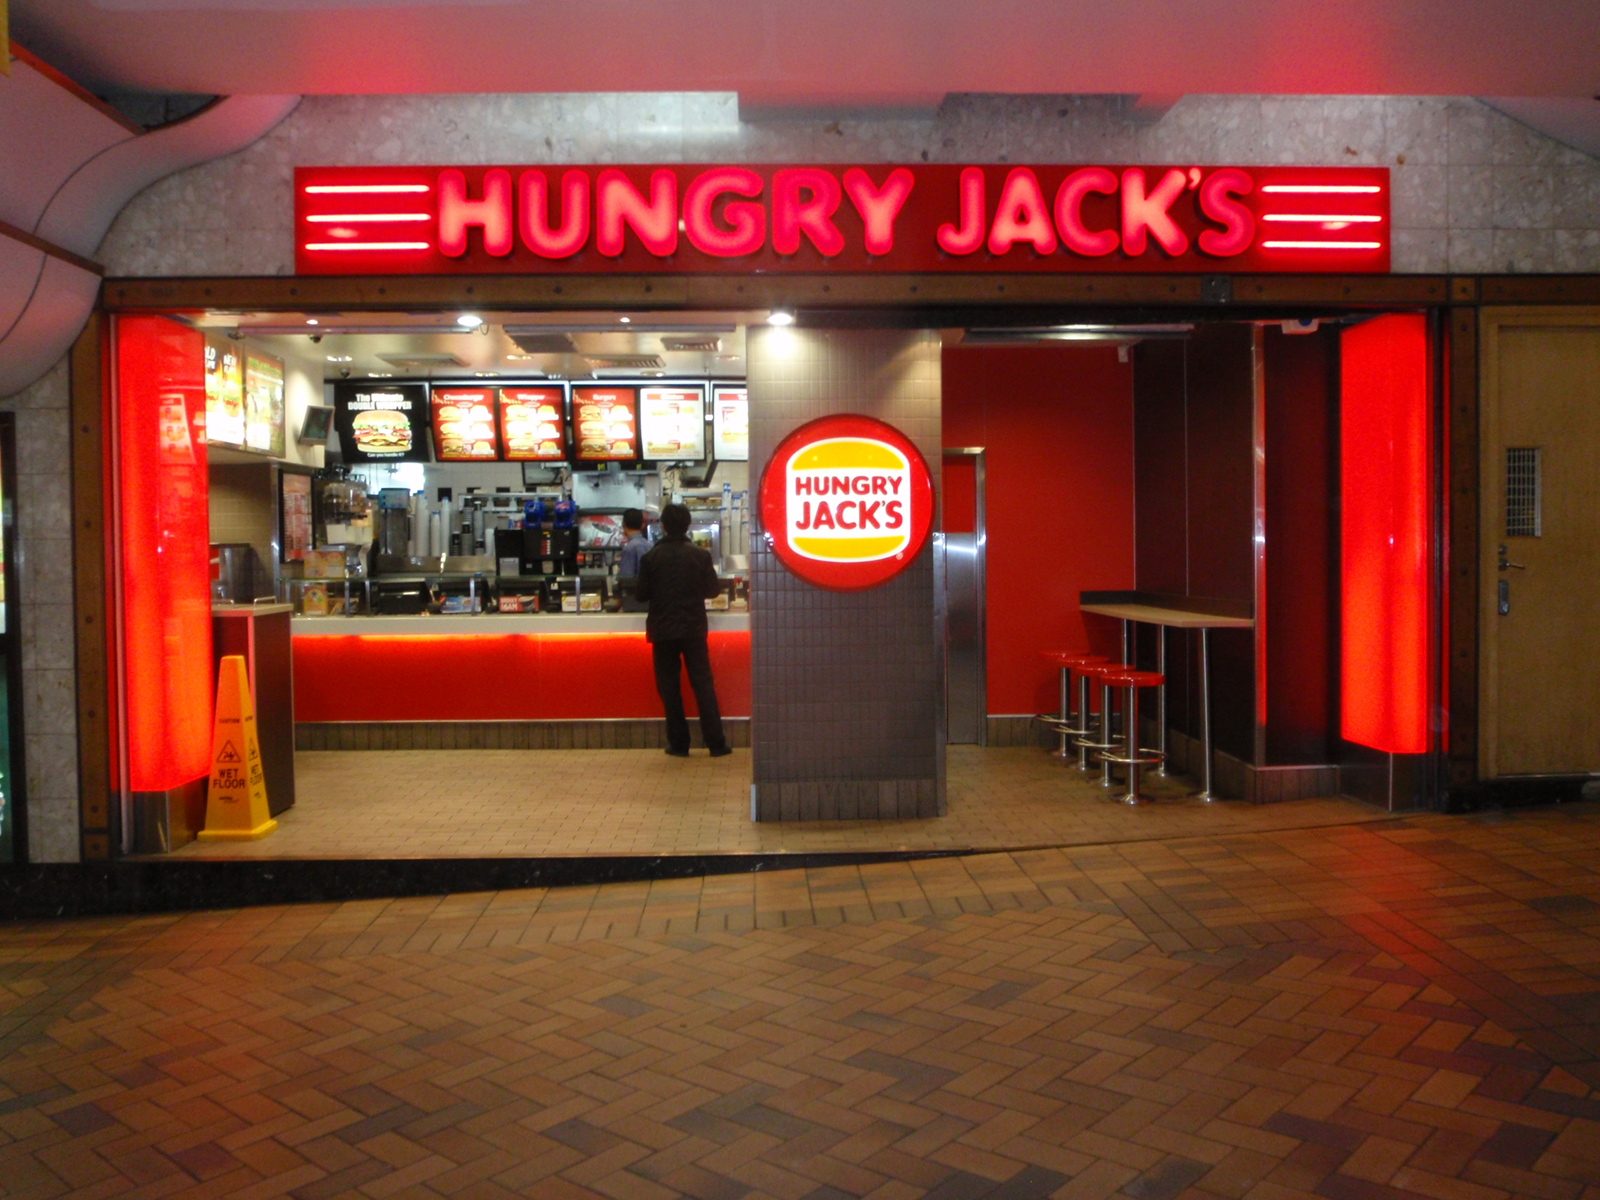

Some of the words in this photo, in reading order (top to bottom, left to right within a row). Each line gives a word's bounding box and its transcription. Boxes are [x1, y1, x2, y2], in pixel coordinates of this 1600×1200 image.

[437, 167, 914, 259] HUNGRY
[937, 166, 1256, 257] JACK'S
[795, 476, 903, 496] HUNGRY
[795, 500, 903, 530] JACK'S
[219, 768, 239, 778] WET
[213, 779, 246, 789] FLOOR
